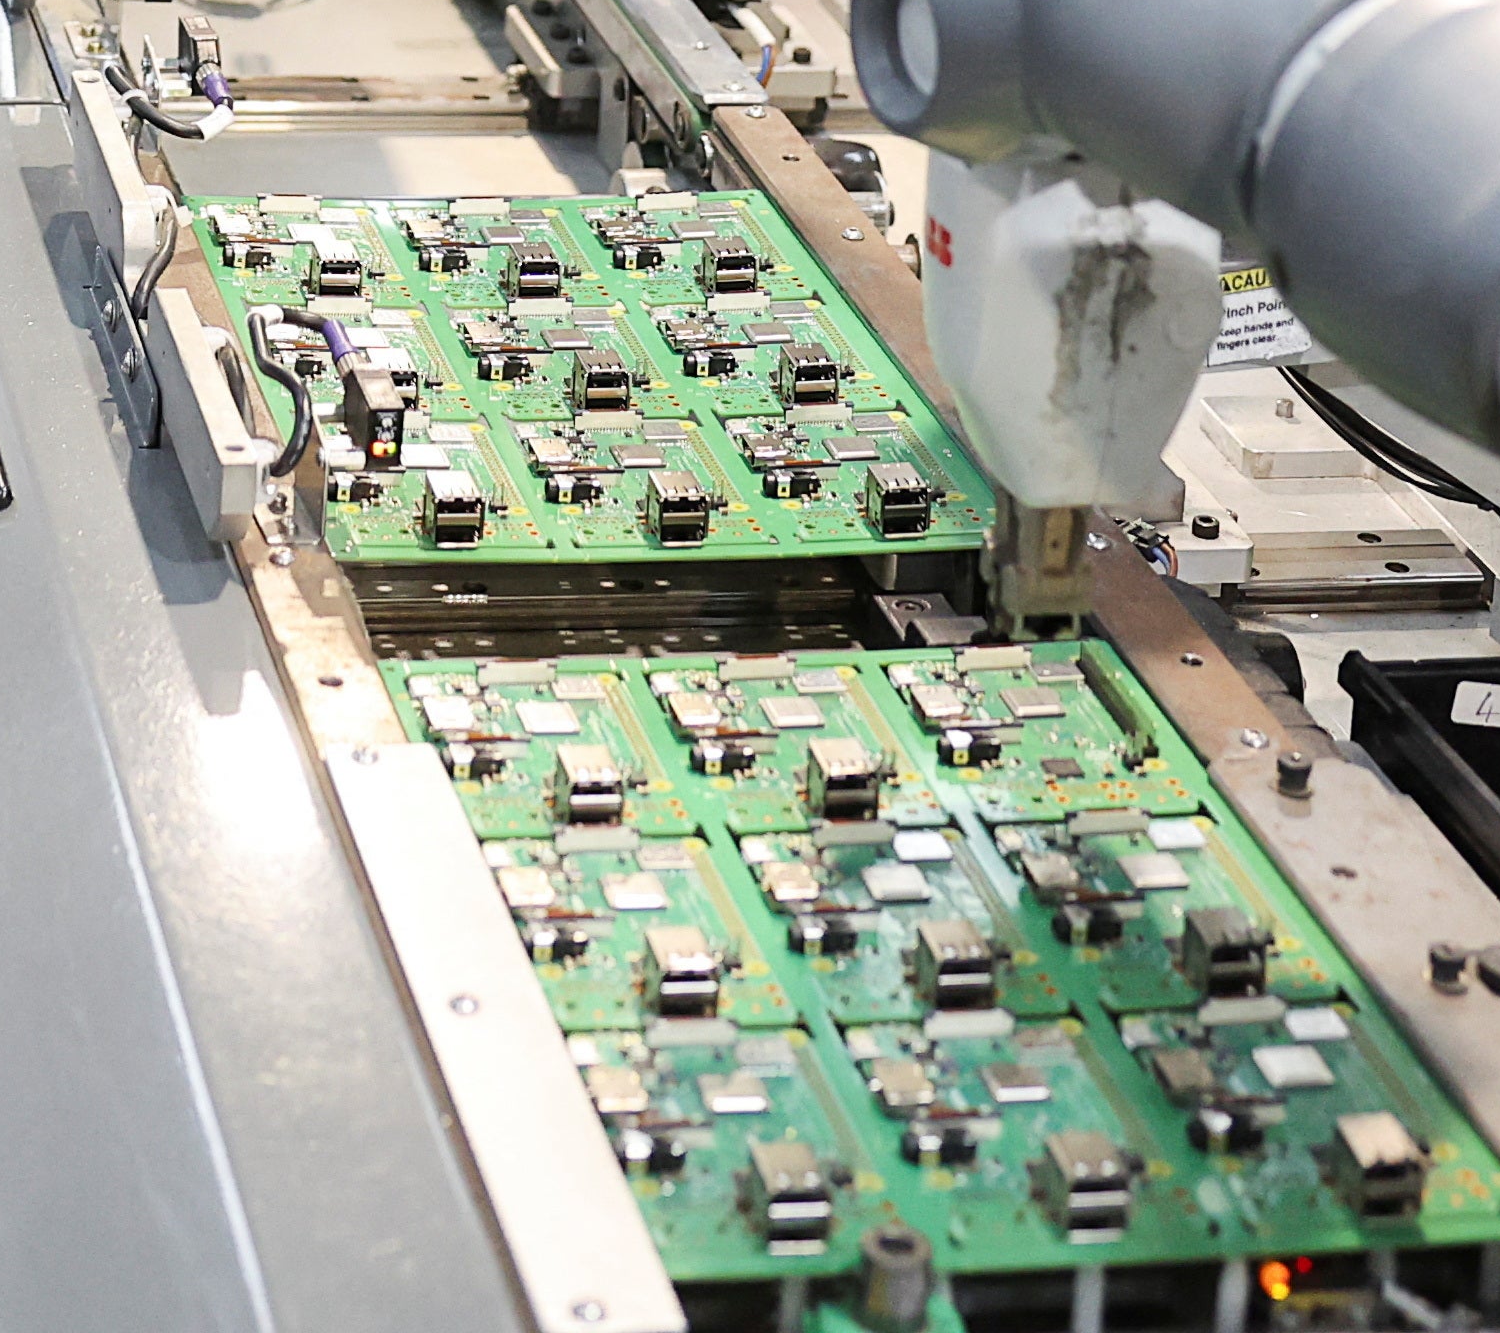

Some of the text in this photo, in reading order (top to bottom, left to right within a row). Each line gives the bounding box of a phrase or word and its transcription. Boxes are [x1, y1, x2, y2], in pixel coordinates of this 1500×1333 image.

[1223, 303, 1254, 320] inch
[1243, 319, 1274, 334] hands
[1216, 337, 1250, 351] fingers
